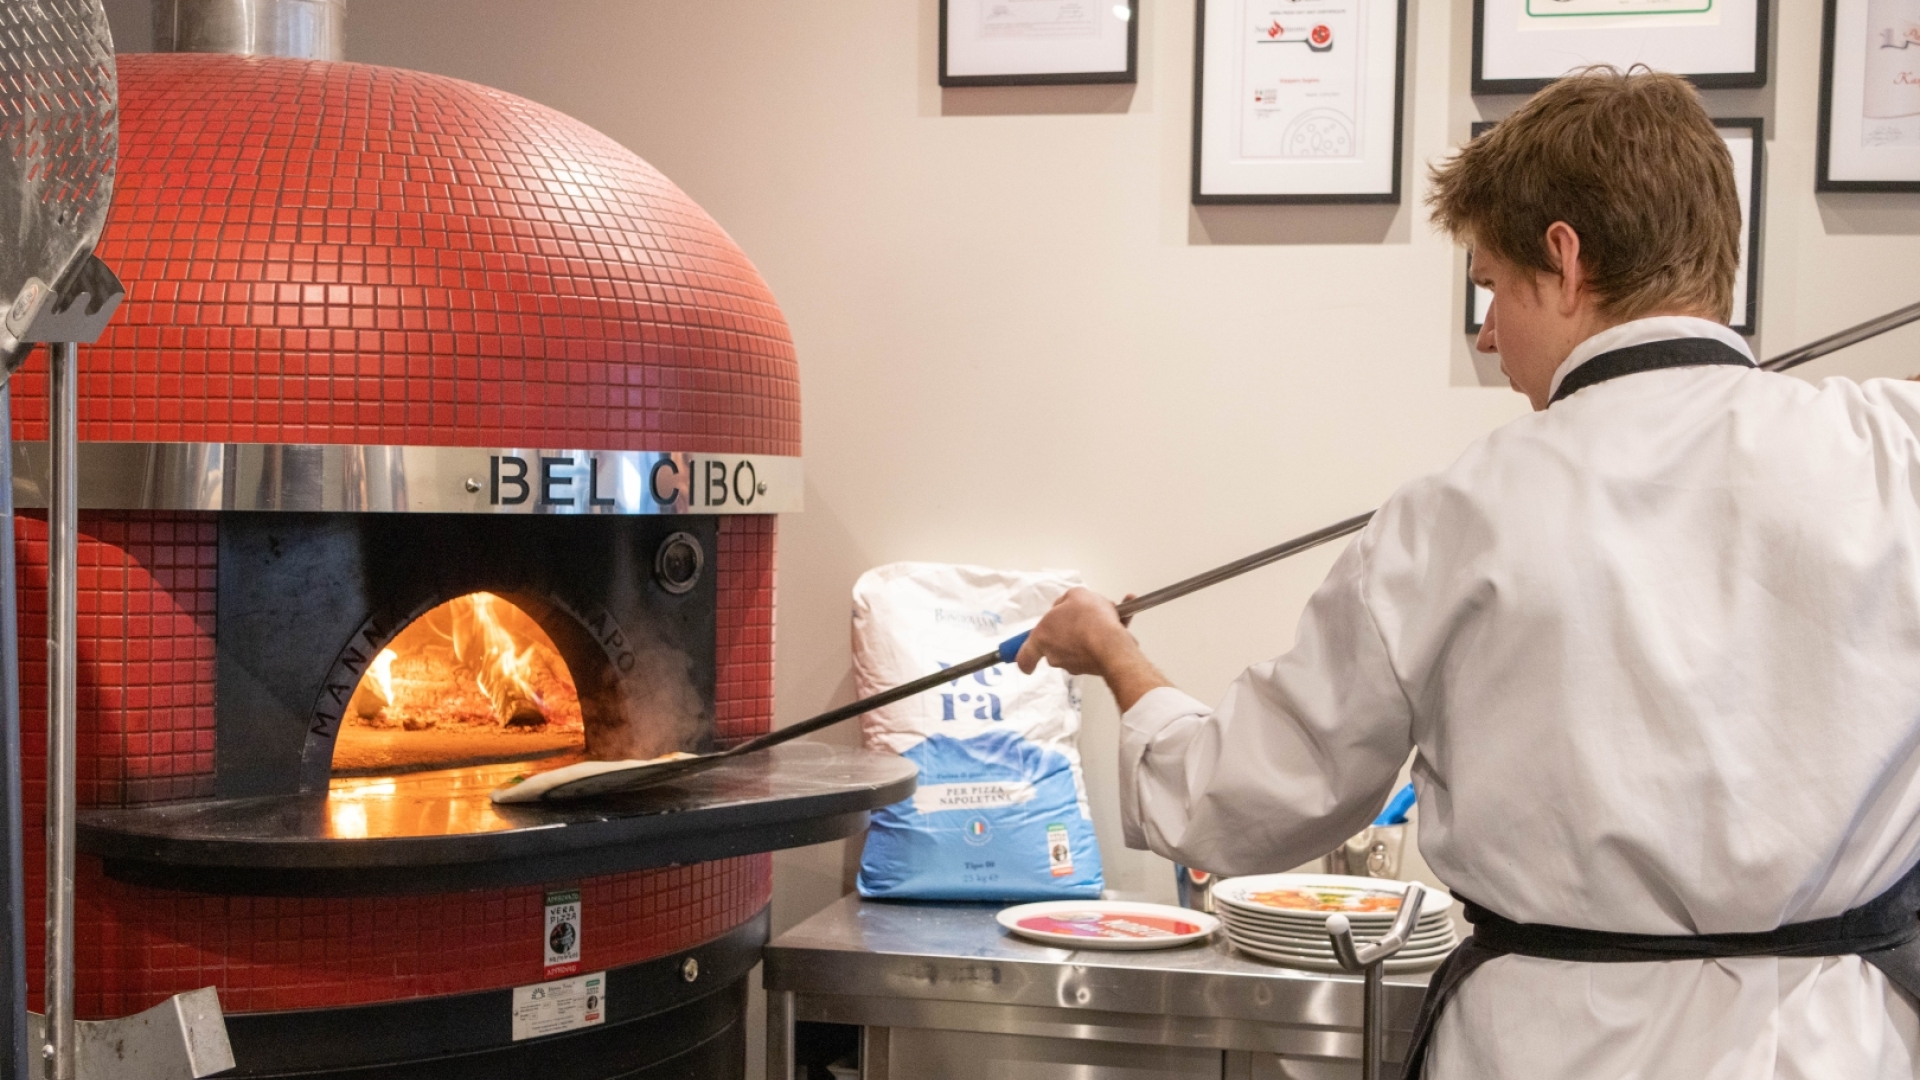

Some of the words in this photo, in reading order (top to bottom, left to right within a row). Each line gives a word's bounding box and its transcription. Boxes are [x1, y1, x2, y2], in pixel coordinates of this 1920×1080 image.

[490, 455, 615, 507] BEL
[651, 458, 756, 507] CIBO
[940, 692, 1004, 721] ra
[946, 788, 968, 796] PER
[971, 786, 1004, 795] PIZZA
[940, 794, 1012, 805] NAPOLETANA
[964, 862, 984, 870] Tipo
[550, 905, 574, 915] VERA
[550, 912, 576, 924] PIZZA
